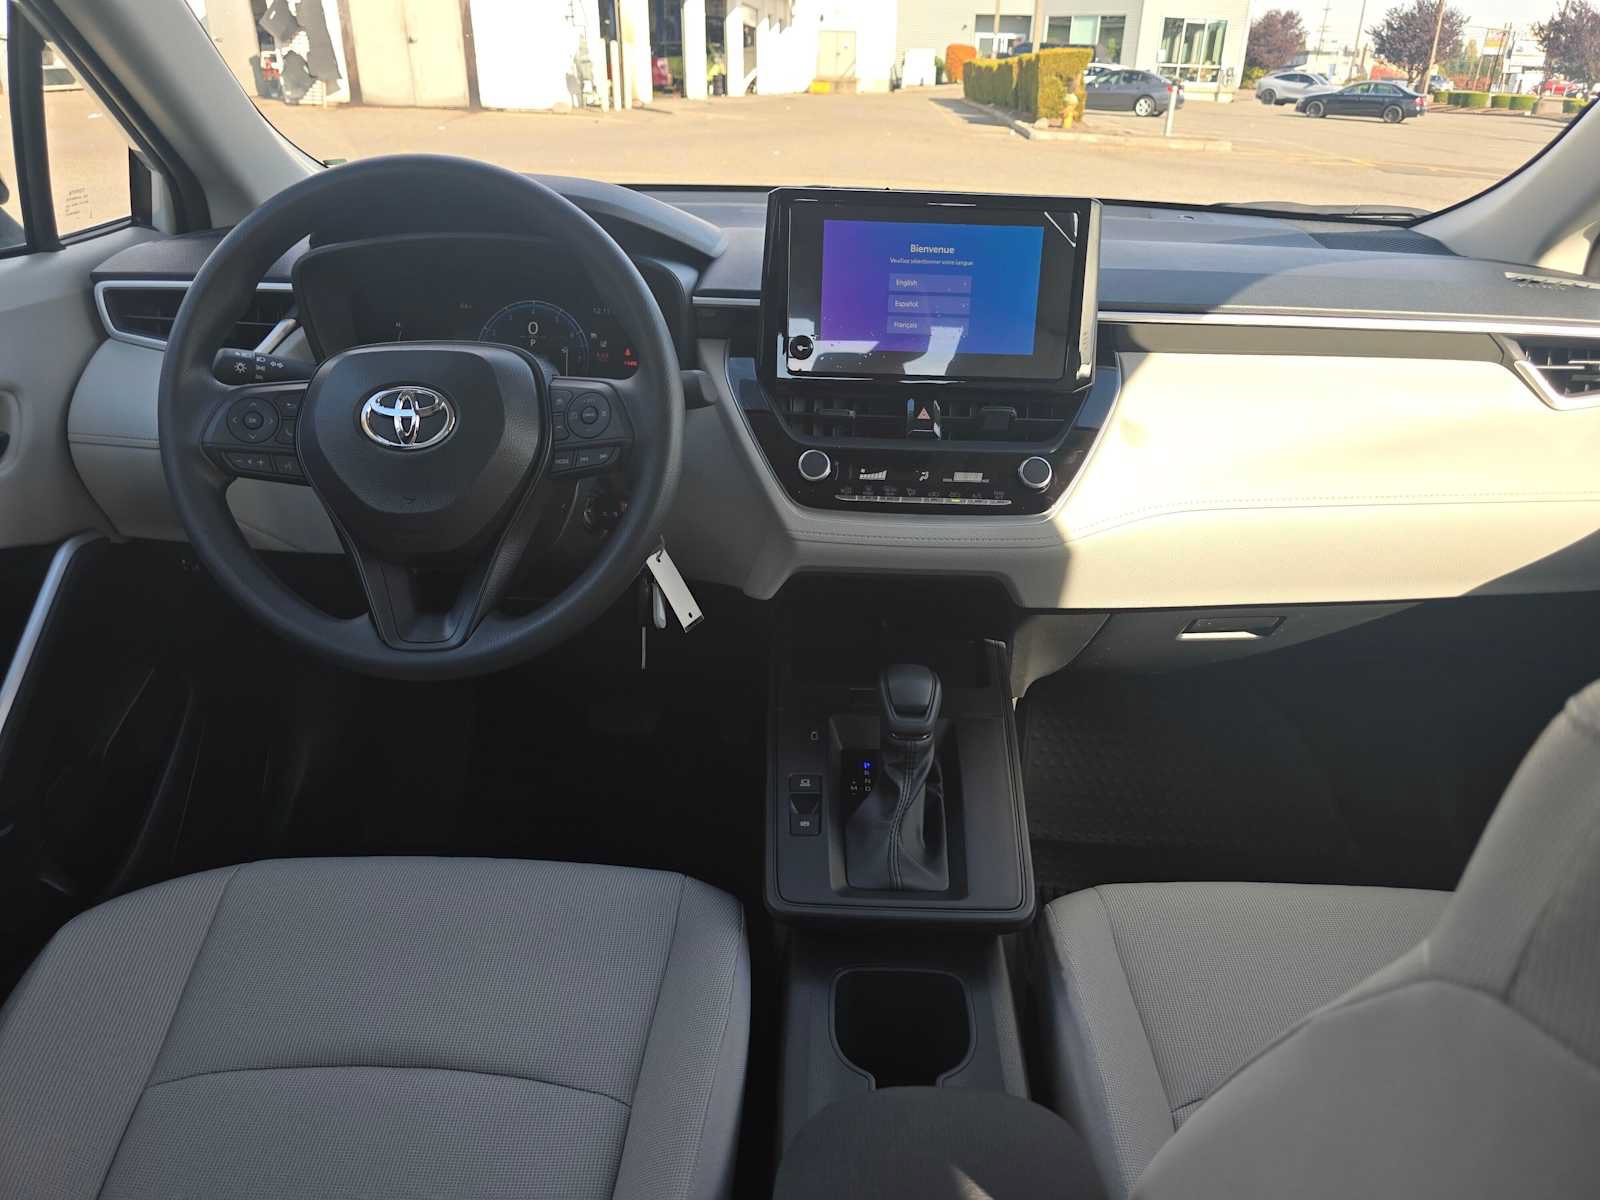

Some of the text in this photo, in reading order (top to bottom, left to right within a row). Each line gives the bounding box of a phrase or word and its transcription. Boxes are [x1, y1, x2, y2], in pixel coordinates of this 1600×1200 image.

[910, 243, 955, 254] Bienvenue
[896, 279, 918, 288] English
[895, 300, 919, 309] Español
[894, 320, 917, 329] Français
[530, 339, 537, 347] P
